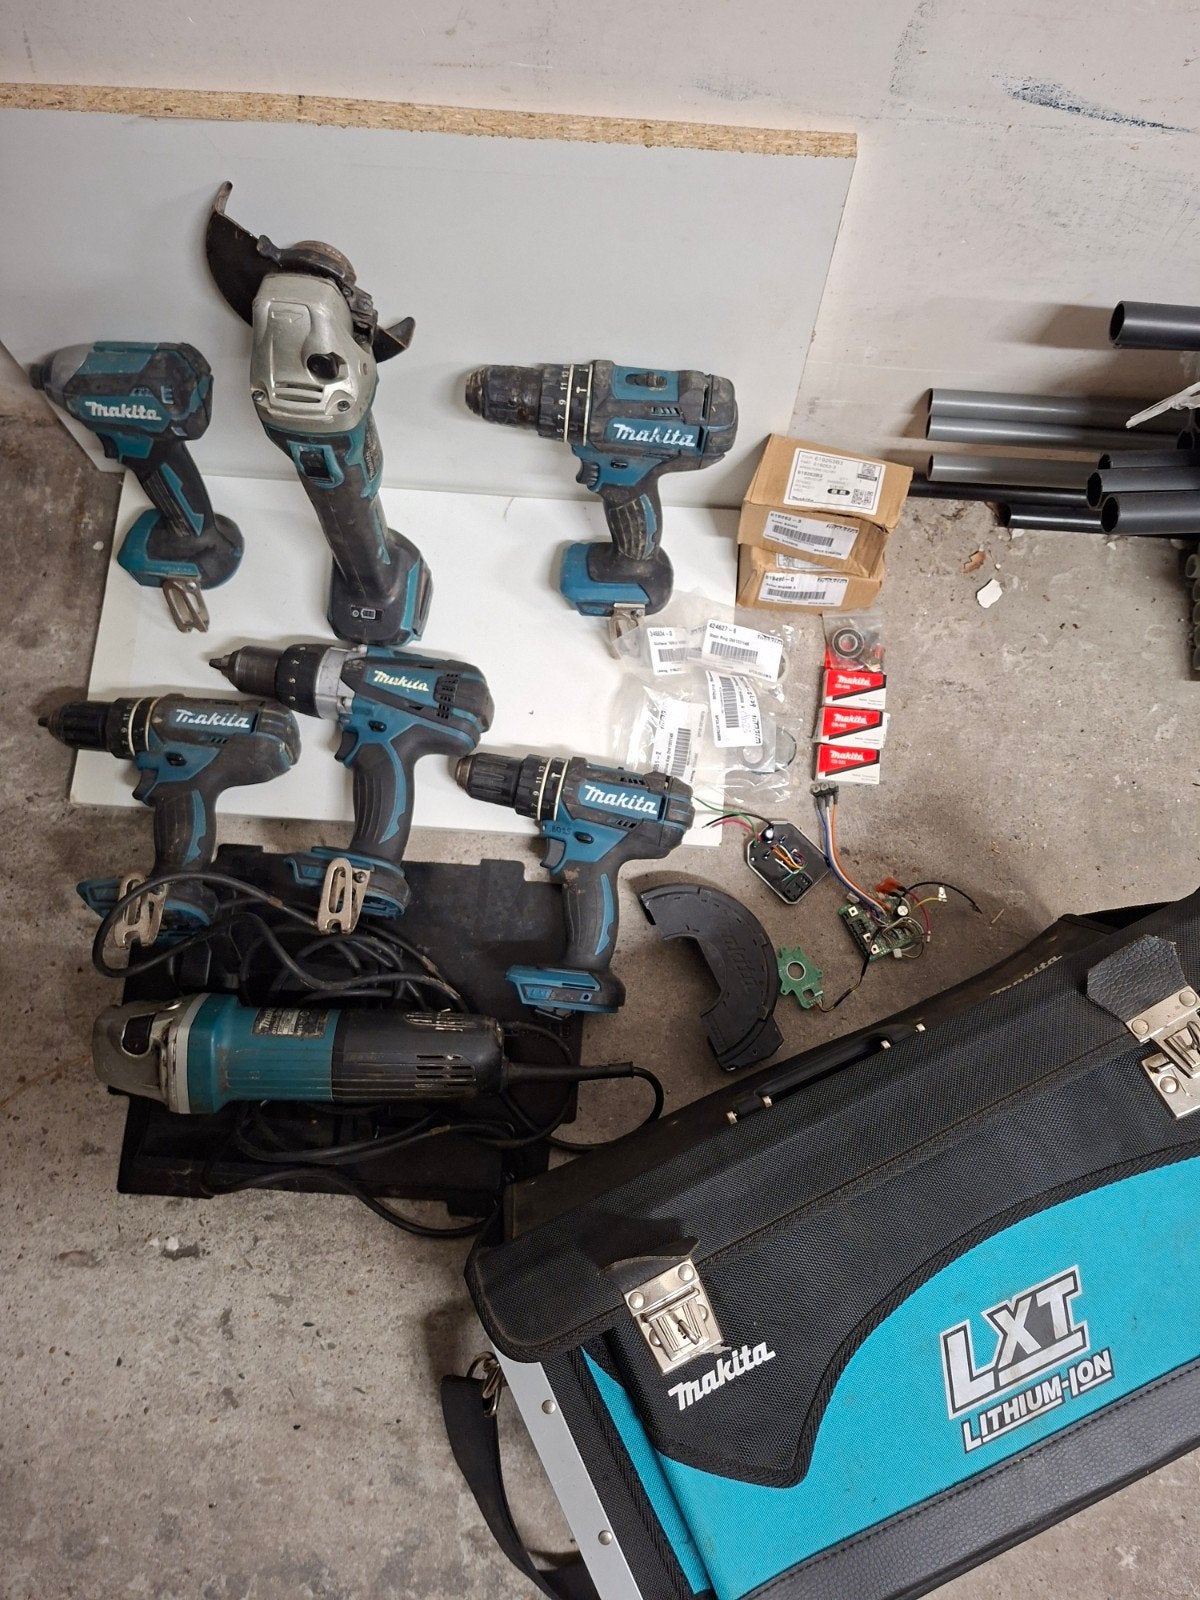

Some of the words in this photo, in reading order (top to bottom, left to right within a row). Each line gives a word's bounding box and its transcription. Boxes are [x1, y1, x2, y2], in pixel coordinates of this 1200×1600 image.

[85, 400, 162, 422] Makita
[613, 422, 696, 448] Makita
[373, 669, 430, 692] Makita
[836, 674, 872, 687] Makita
[174, 708, 251, 729] Makita
[833, 713, 869, 726] Makita
[829, 750, 865, 763] Makita
[584, 785, 658, 814] Makita
[939, 1264, 1091, 1420] LXT
[667, 1341, 776, 1412] Makita
[960, 1347, 1115, 1454] LITHIUM-ION
